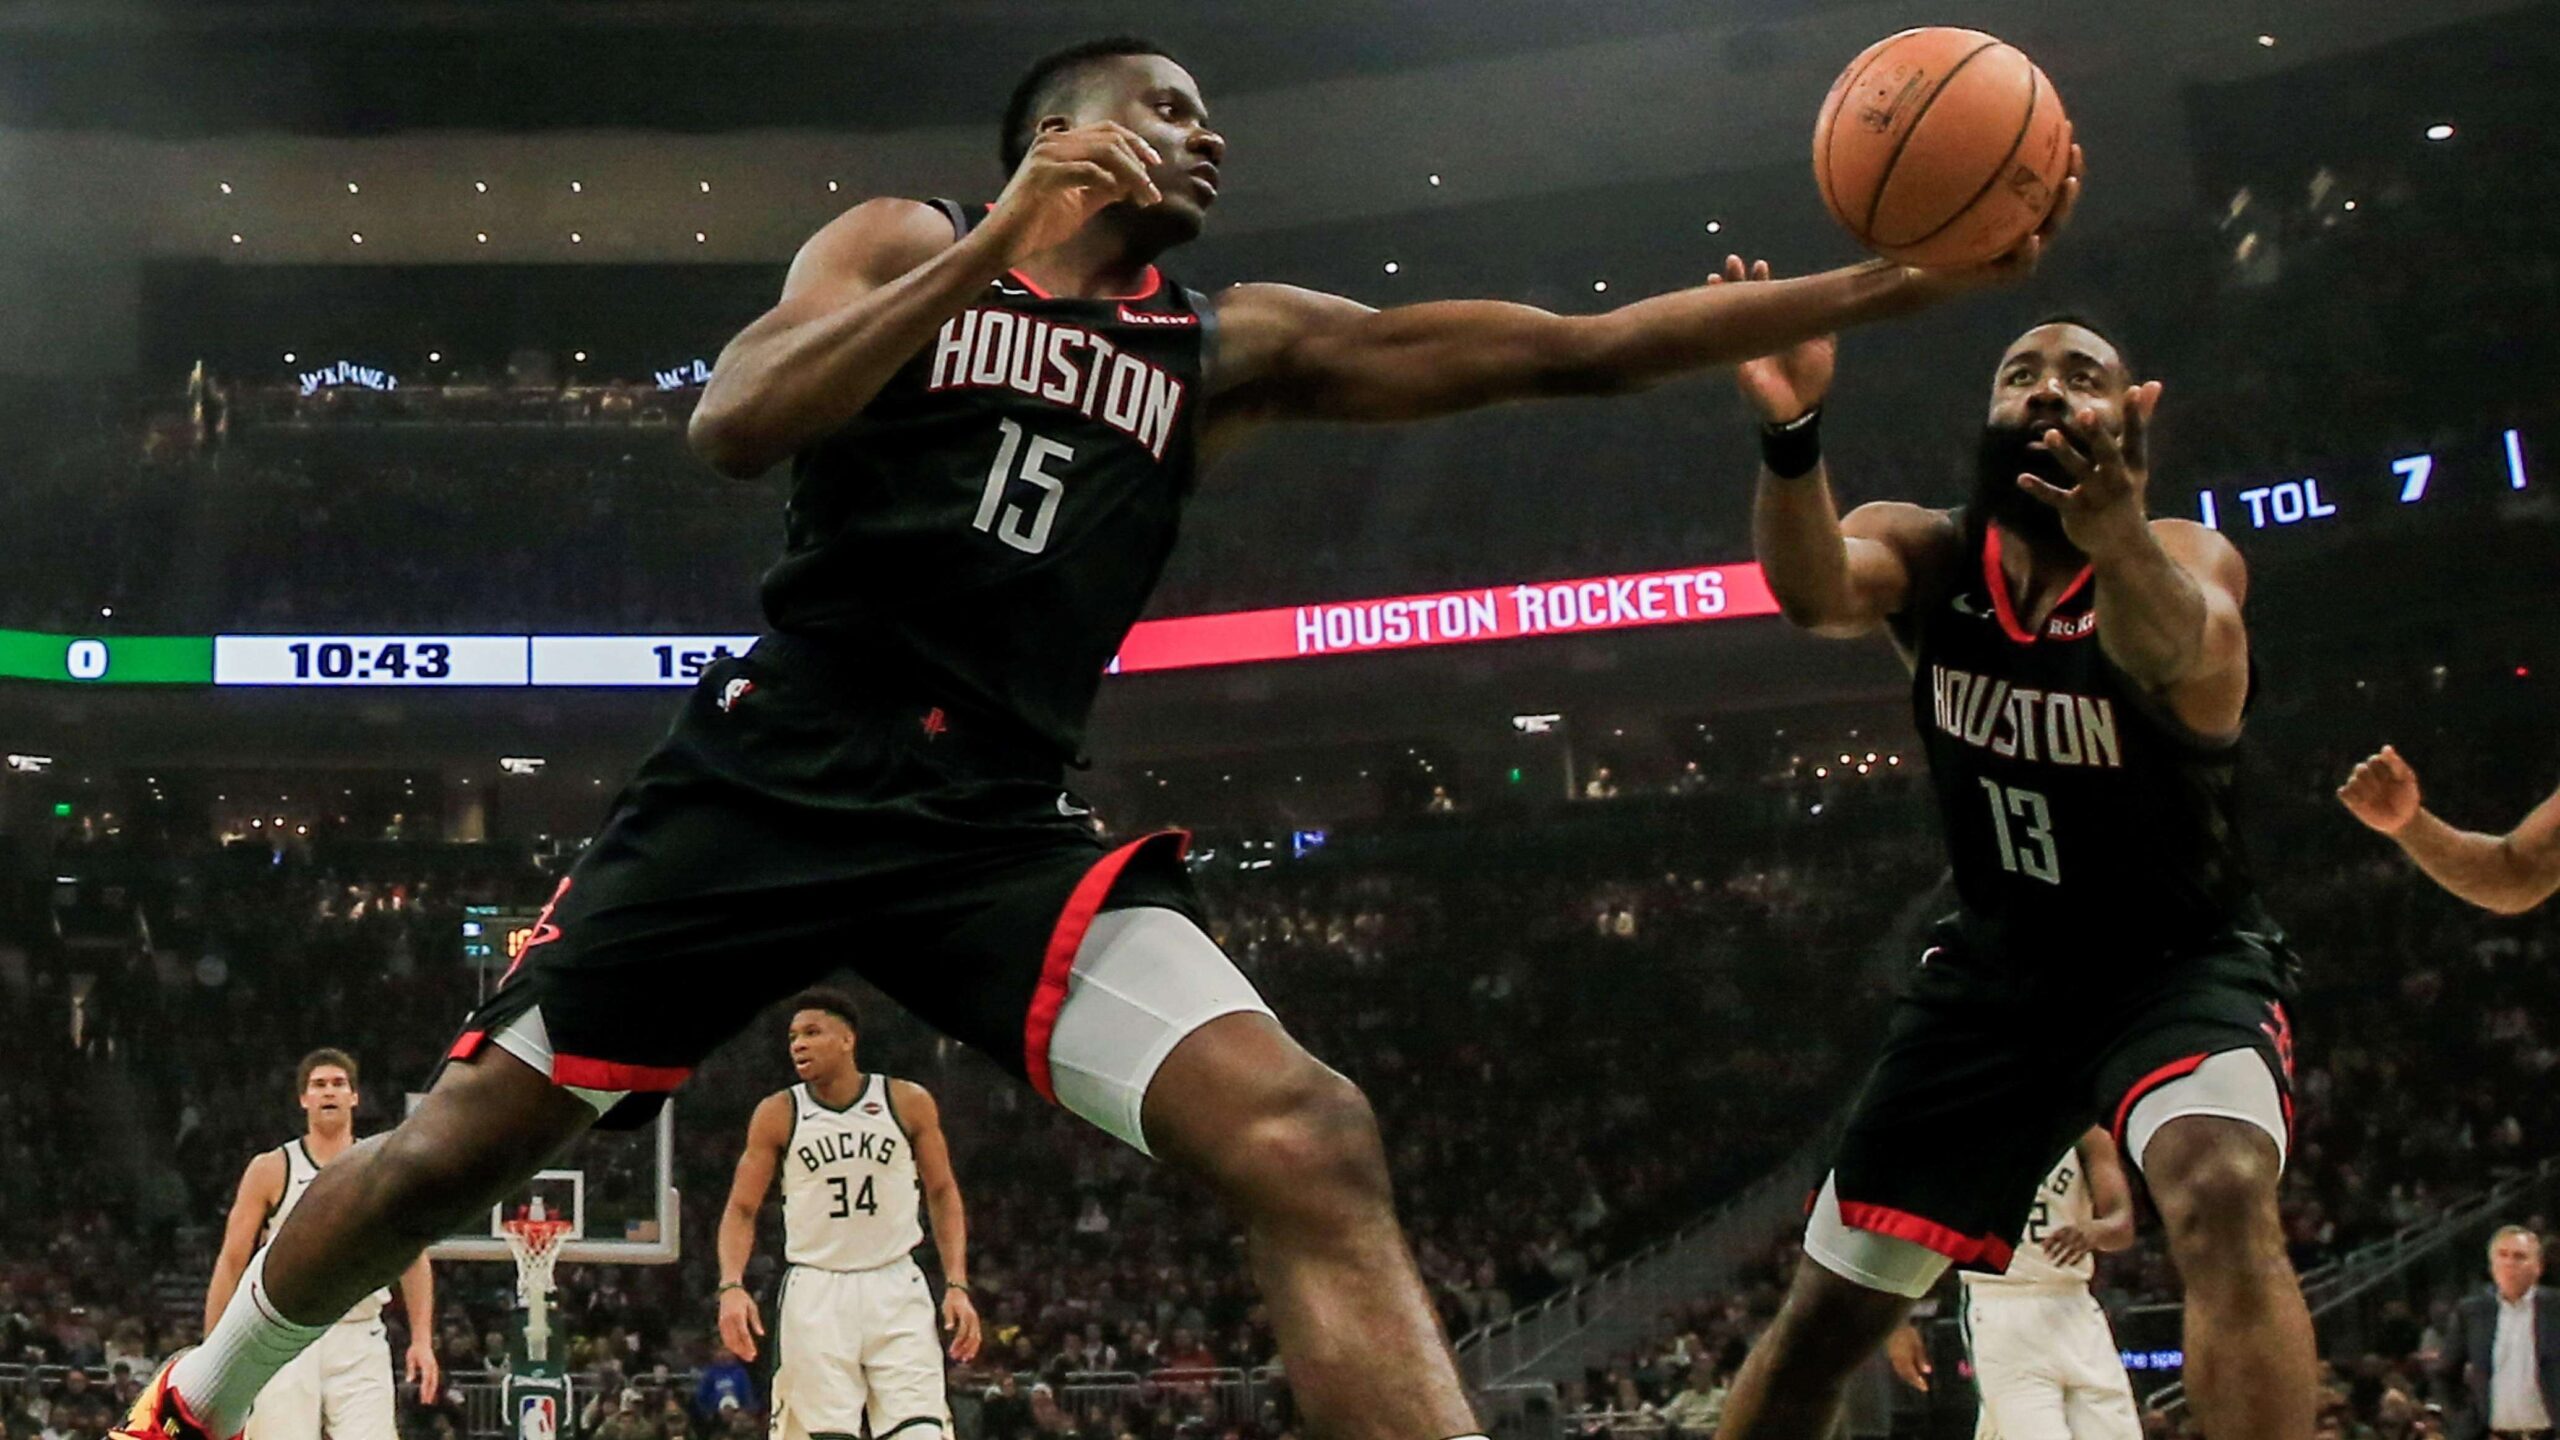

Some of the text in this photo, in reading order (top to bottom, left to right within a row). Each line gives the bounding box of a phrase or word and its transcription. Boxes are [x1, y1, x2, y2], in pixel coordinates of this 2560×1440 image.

[928, 308, 1184, 462] HOUSTON
[972, 416, 1074, 554] 15
[2239, 478, 2337, 529] TOL
[2391, 454, 2432, 503] 7
[1295, 570, 1726, 655] HOUSTON ROCKETS
[65, 638, 109, 680] 0
[288, 642, 450, 679] 10:43
[1932, 664, 2123, 768] HOUSTON
[1977, 776, 2061, 886] 13
[797, 1131, 897, 1173] BUCKS
[826, 1174, 878, 1219] 34
